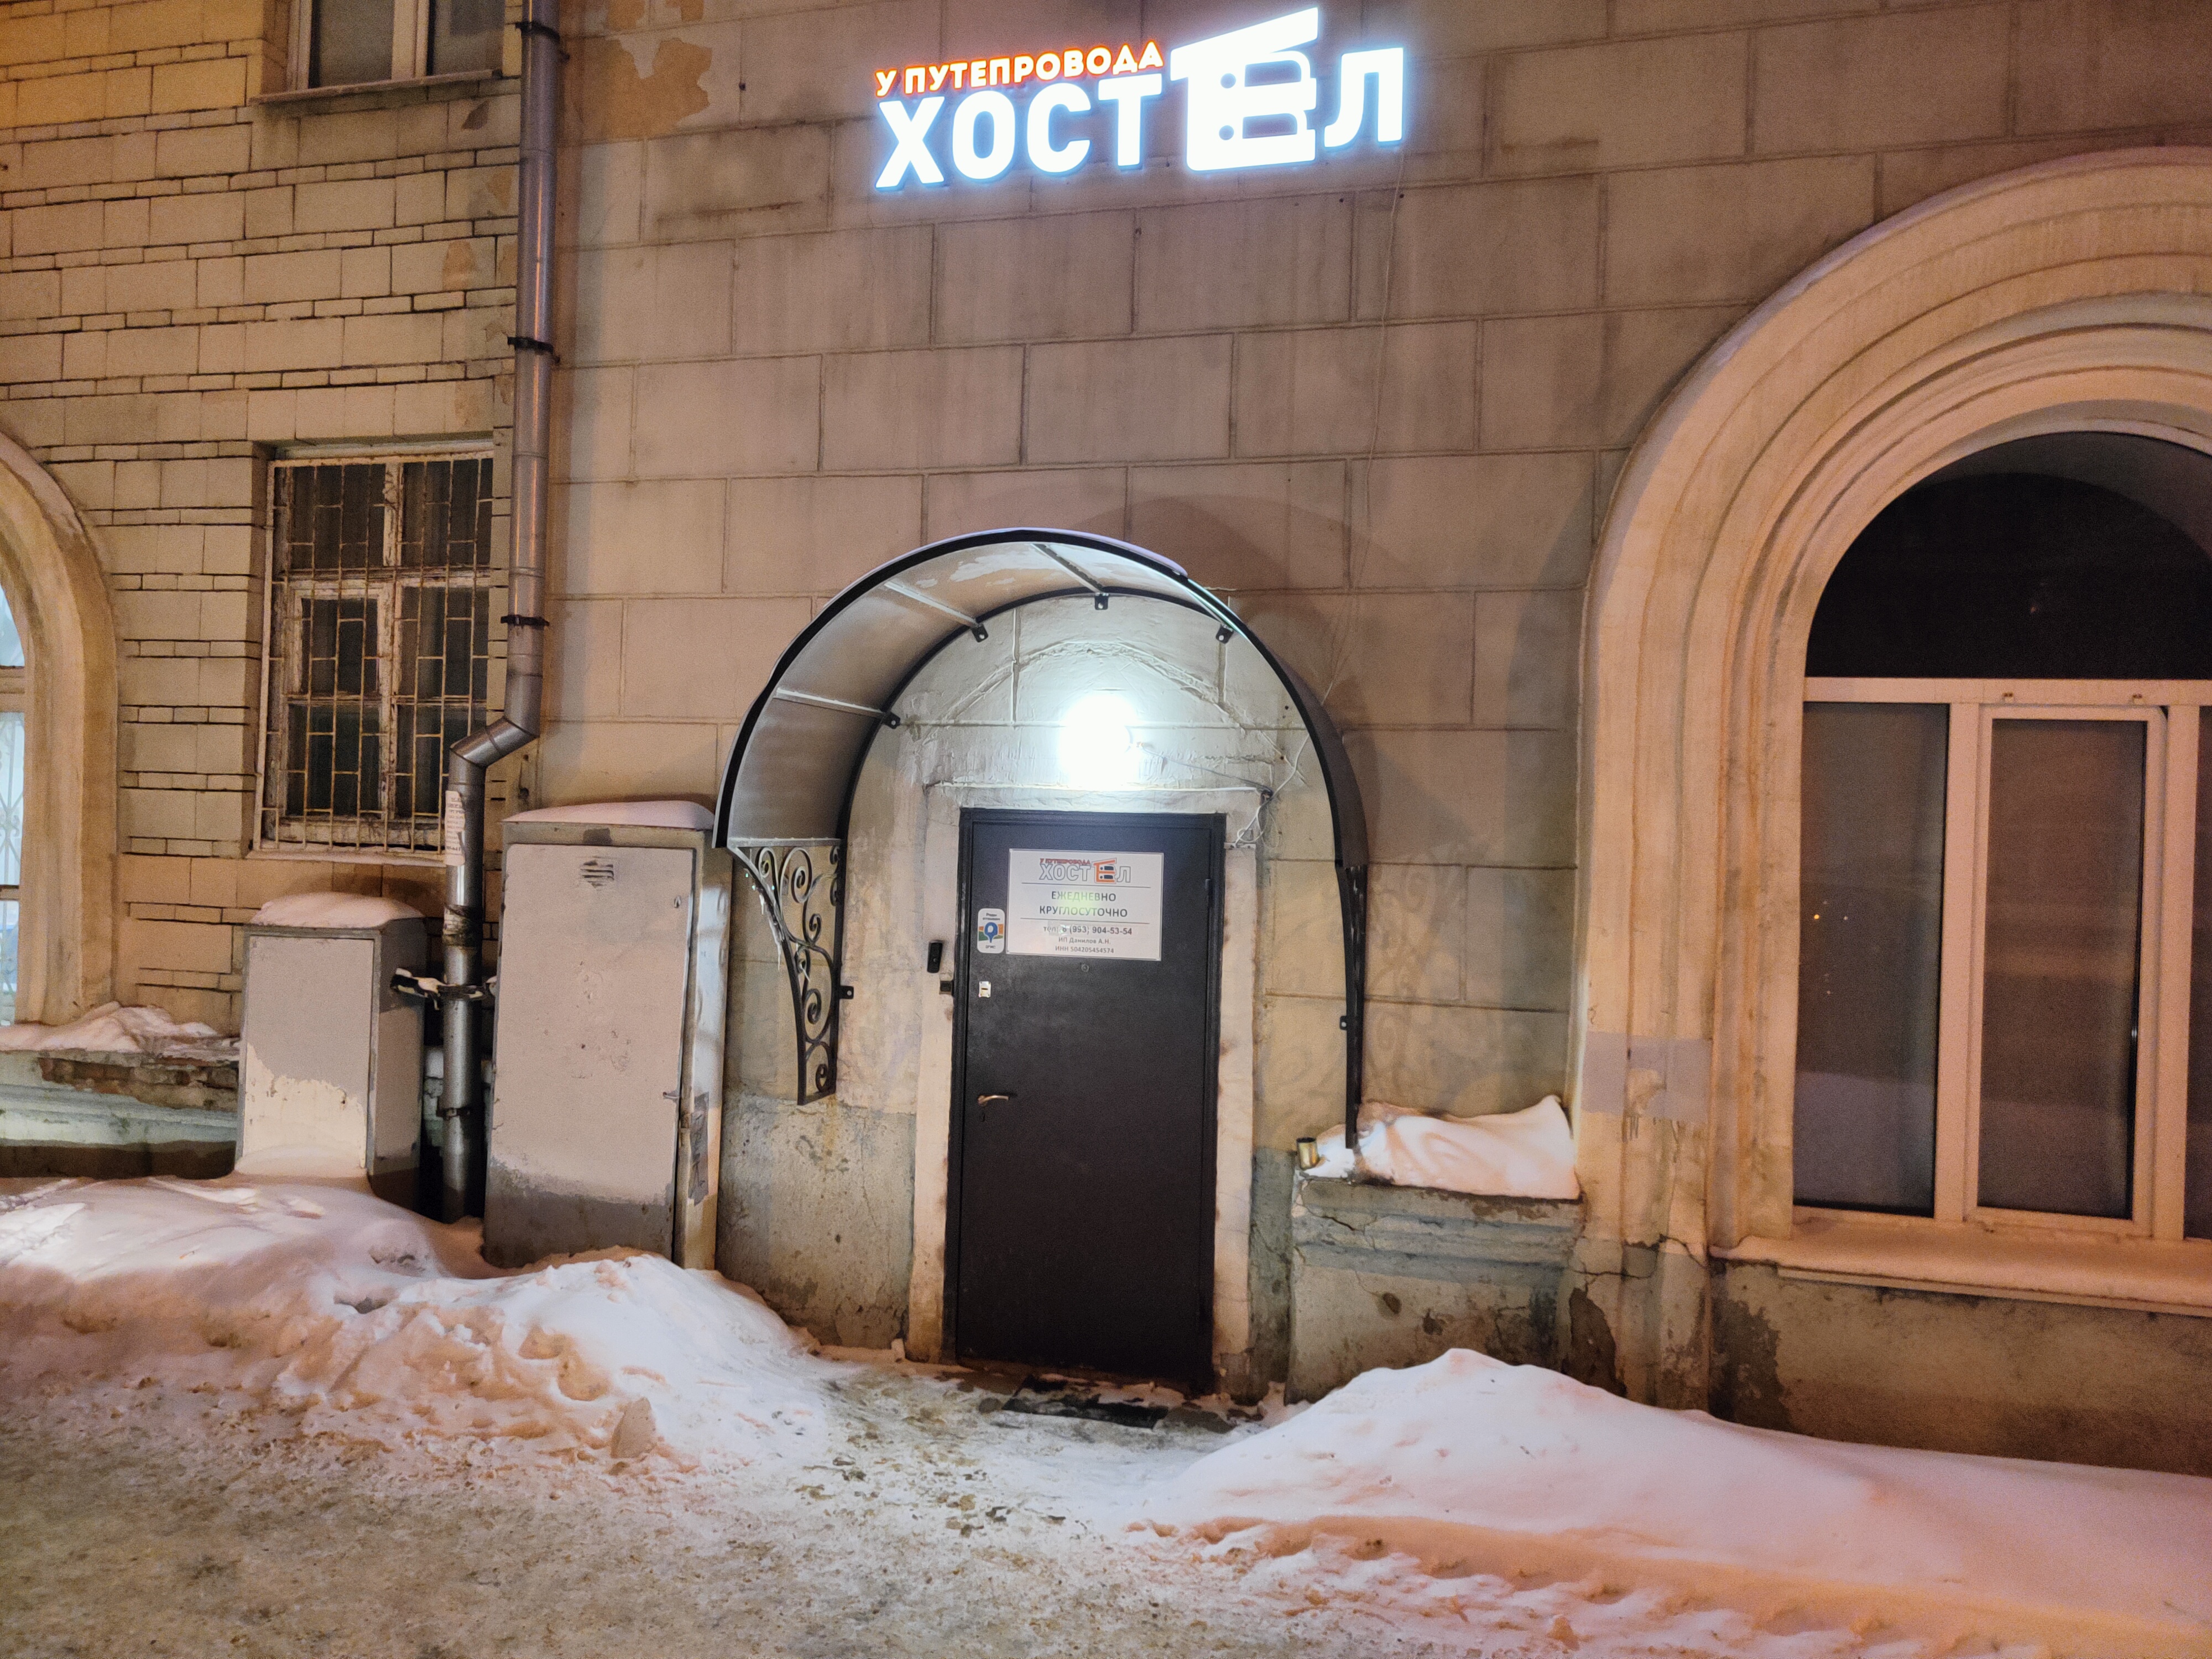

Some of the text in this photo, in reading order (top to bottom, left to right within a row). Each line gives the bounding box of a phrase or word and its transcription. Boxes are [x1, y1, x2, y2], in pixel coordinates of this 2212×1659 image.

[875, 41, 1164, 97] У ПУТЕПРОВОДА
[875, 7, 1405, 189] ХОСТЕЛ
[1039, 858, 1131, 884] ХОСТЕЛ
[1051, 891, 1117, 902] ЕЖЕДНЕВНО
[1039, 905, 1128, 917] КРУГЛОСУТОЧНО
[1092, 926, 1133, 935] 904-53-54
